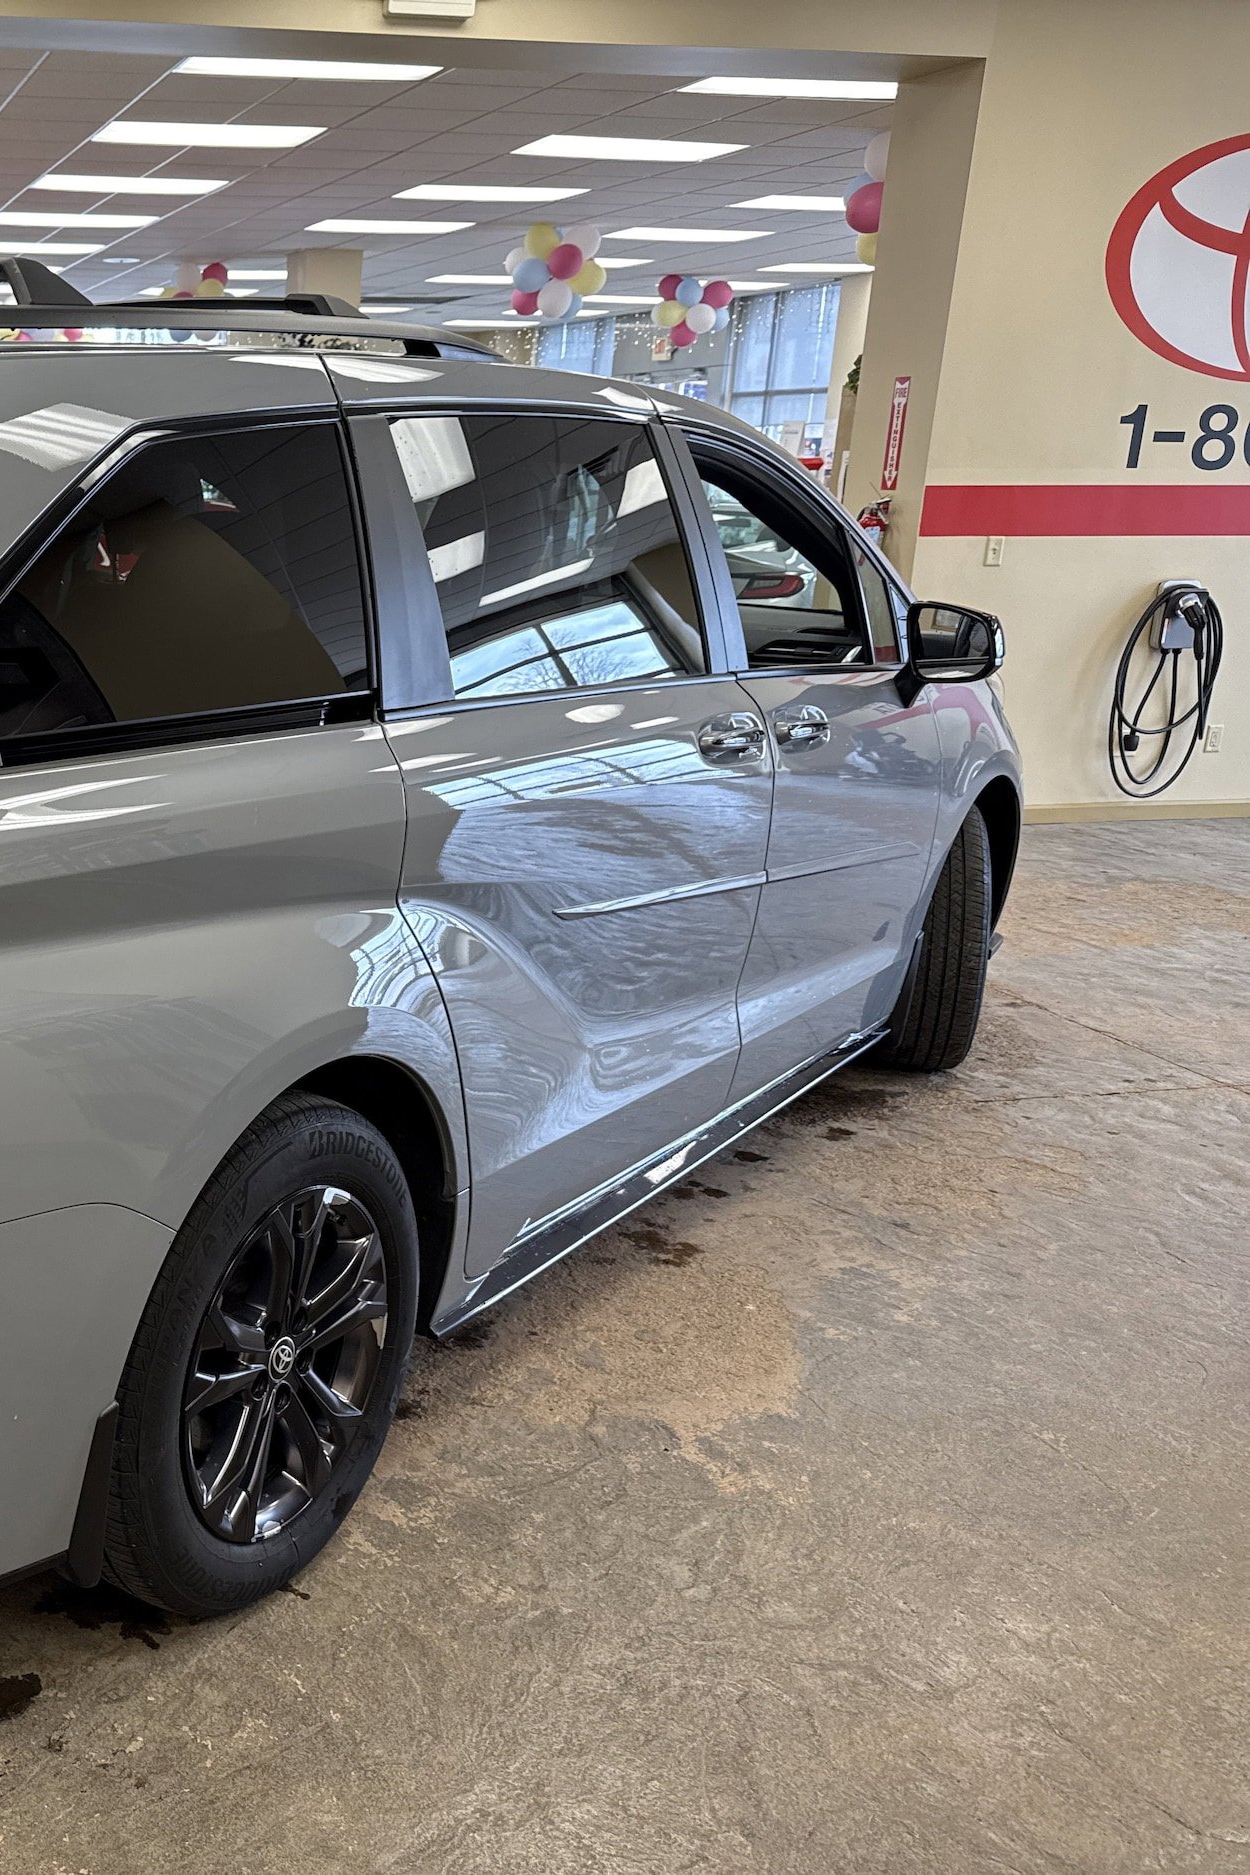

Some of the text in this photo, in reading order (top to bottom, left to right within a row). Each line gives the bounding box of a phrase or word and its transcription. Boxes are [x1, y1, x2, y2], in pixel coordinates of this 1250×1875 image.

[895, 387, 907, 398] FIRE
[887, 402, 902, 481] EXTINGUISHER
[1119, 404, 1250, 471] 1-8
[307, 1130, 408, 1208] BRIDGESTONE
